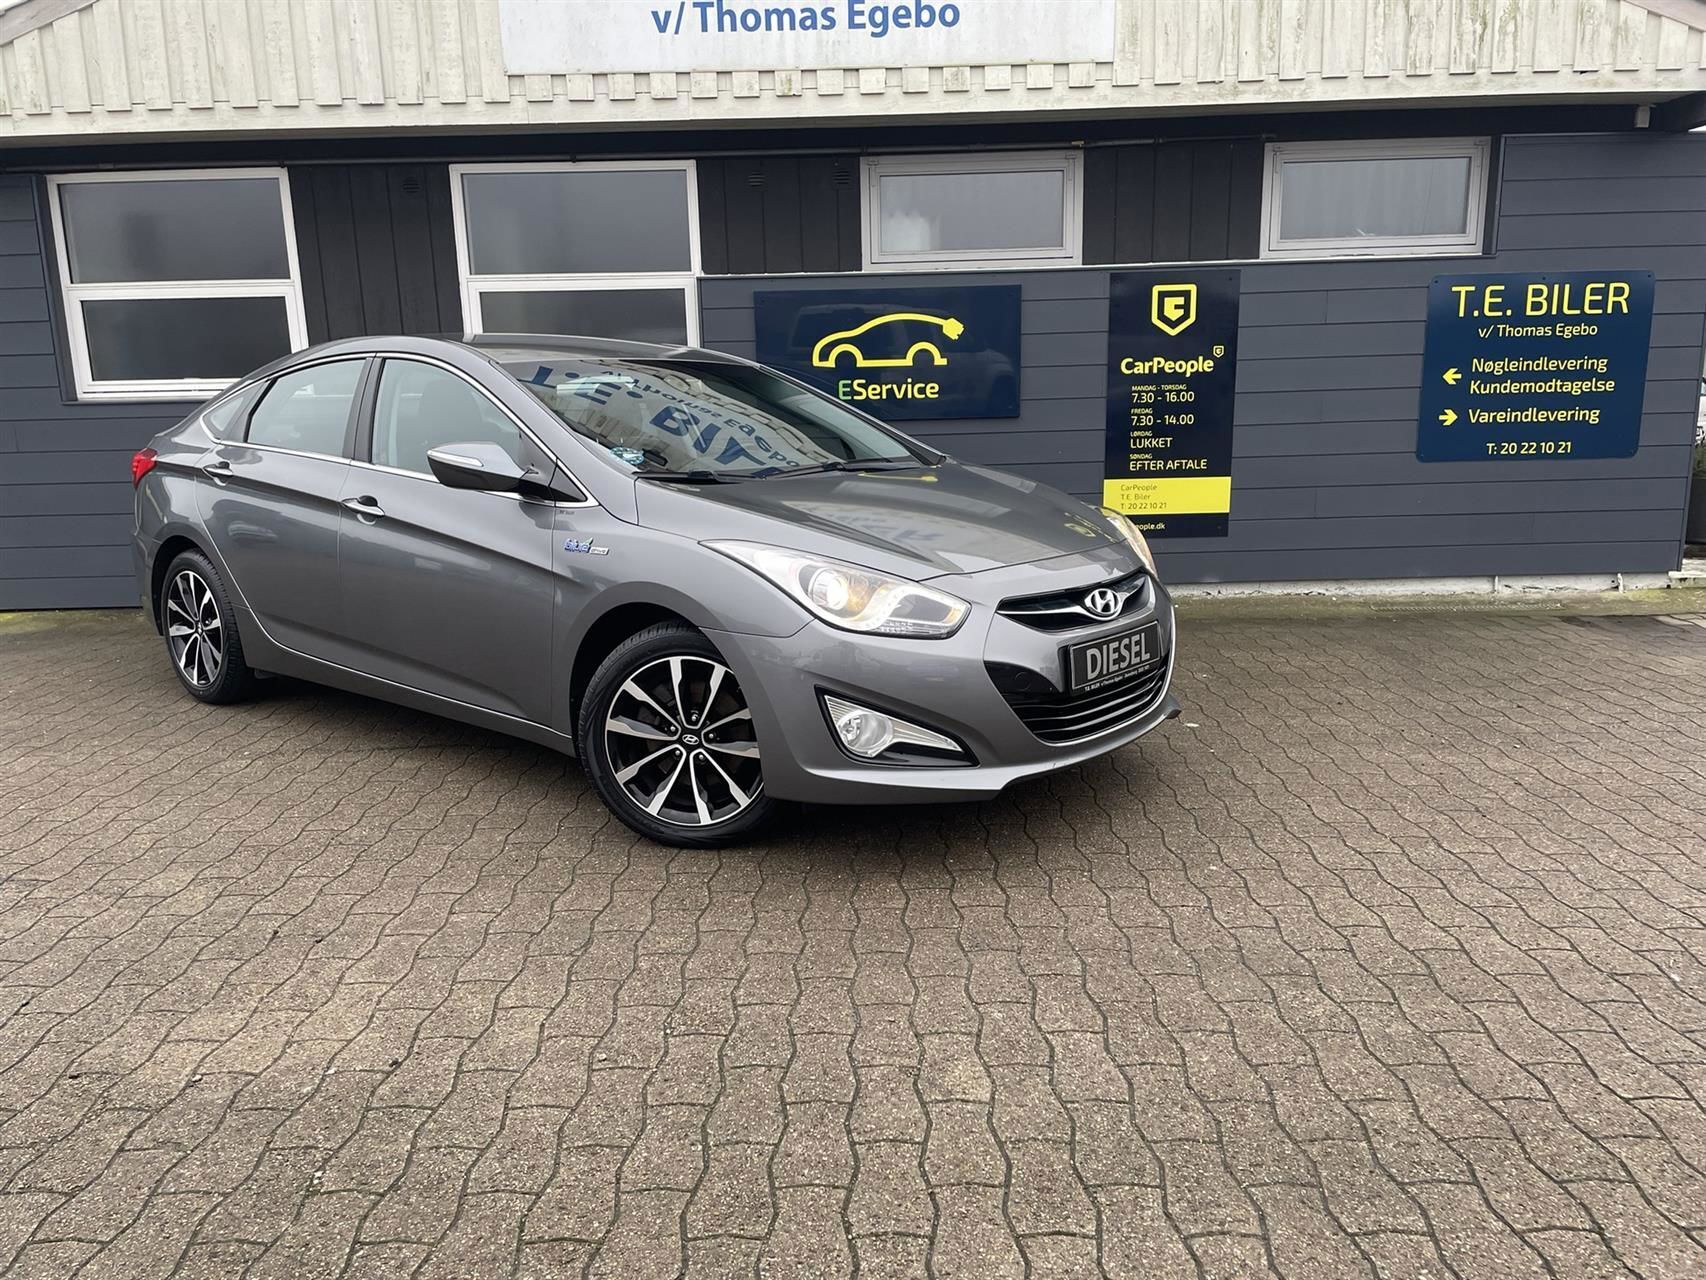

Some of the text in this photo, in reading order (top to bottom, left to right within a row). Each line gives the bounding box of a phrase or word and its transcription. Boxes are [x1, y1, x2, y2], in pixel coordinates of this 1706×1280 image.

[651, 0, 960, 38] v/ Thomas Egebo
[1451, 282, 1631, 317] T.E. BILER
[1478, 323, 1598, 339] v/ Thomas Egebo
[1121, 356, 1214, 377] CarPeople
[1471, 356, 1609, 376] Nøgleindlevering
[838, 378, 939, 400] EService
[1469, 377, 1616, 395] Kundemodtagelse
[1131, 392, 1155, 403] 7.30
[1165, 391, 1195, 402] 16.00
[1130, 415, 1154, 426] 7.30
[1164, 414, 1195, 425] 14.00
[1469, 407, 1600, 425] Vareindlevering
[1130, 437, 1173, 449] LUKKET
[1486, 441, 1572, 455] T: 20 22 10 21
[1129, 458, 1208, 471] EFTER AFTALE
[1121, 484, 1157, 492] CarPeople
[1128, 502, 1137, 510] 20
[1138, 502, 1148, 510] 22
[1149, 502, 1158, 510] 10
[1086, 632, 1151, 680] DIESEL
